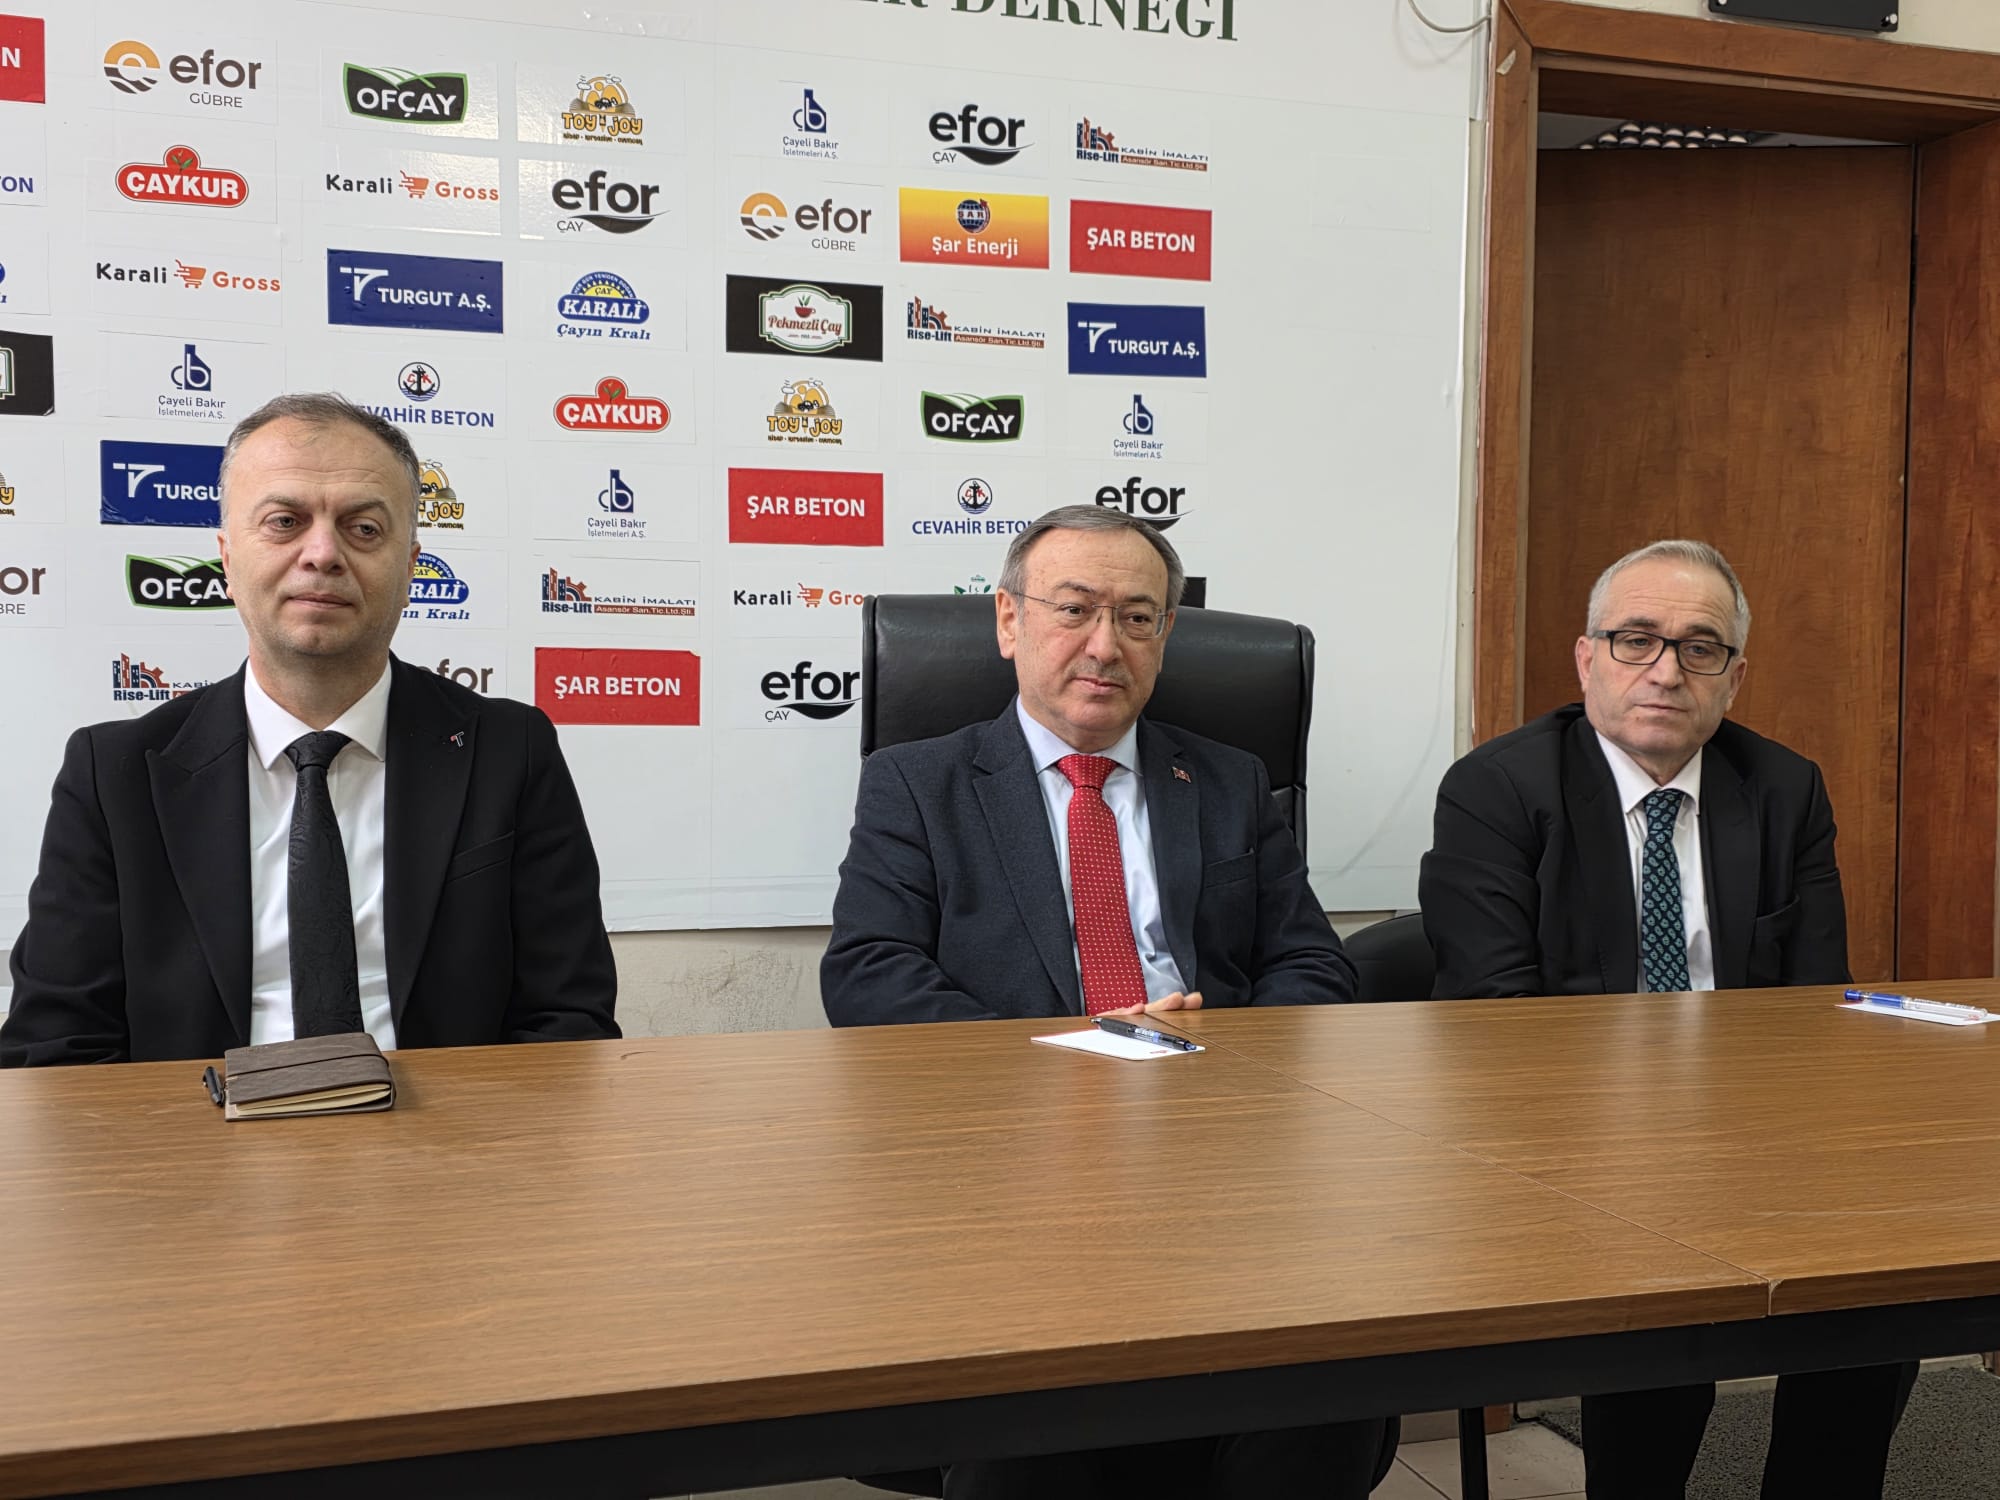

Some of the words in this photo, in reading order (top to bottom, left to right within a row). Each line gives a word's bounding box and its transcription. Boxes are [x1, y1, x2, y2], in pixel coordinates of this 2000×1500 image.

[169, 49, 262, 89] efor
[189, 92, 242, 108] GÜBRE
[356, 87, 456, 117] OFÇAY
[928, 104, 1025, 148] efor
[783, 136, 811, 148] Çayeli
[814, 138, 838, 149] Bakır
[933, 151, 957, 164] ÇAY
[1076, 150, 1119, 163] Rise-Lift
[126, 171, 239, 200] ÇAYKUR
[326, 174, 392, 194] Karali
[434, 181, 499, 201] Gross
[552, 170, 660, 214] efor
[556, 220, 584, 232] ÇAY
[794, 198, 872, 234] efor
[812, 237, 856, 252] GÜBRE
[932, 236, 958, 255] Şar
[968, 237, 1018, 258] Enerji
[1086, 228, 1125, 250] ŞAR
[1130, 231, 1196, 252] BETON
[96, 262, 166, 284] Karali
[212, 271, 280, 292] Gross
[378, 287, 454, 307] TURGUT
[458, 293, 491, 312] A.Ş.
[562, 298, 642, 320] KARALİ
[556, 323, 602, 338] Çayın
[608, 327, 651, 340] Kralı
[768, 315, 819, 331] Pekmezli
[820, 318, 842, 336] Çay
[907, 329, 952, 342] Rise-Lift
[1108, 338, 1168, 355] TURGUT
[1172, 342, 1200, 359] A.Ş.
[158, 394, 192, 408] Çayeli
[196, 398, 226, 408] Bakır
[158, 406, 206, 418] İşletmeleri
[359, 404, 426, 424] VAHİR
[431, 410, 494, 428] BETON
[562, 402, 662, 427] ÇAYKUR
[932, 412, 1014, 438] OFÇAY
[1113, 439, 1138, 450] Çayeli
[1141, 440, 1164, 450] Bakır
[154, 484, 222, 500] TURGU
[1096, 476, 1186, 514] efor
[747, 496, 790, 519] ŞAR
[794, 497, 865, 517] BETON
[588, 517, 618, 529] Çayeli
[620, 518, 646, 528] Bakır
[912, 518, 982, 534] CEVAHİR
[140, 578, 229, 605] OFÇA
[408, 580, 460, 600] RALİ
[734, 590, 792, 605] Karali
[828, 590, 864, 606] Gro
[426, 608, 470, 620] Kralı
[542, 602, 592, 614] Rise-Lift
[594, 595, 636, 604] KABİN
[642, 596, 696, 606] İMALATI
[597, 606, 630, 614] Asansör
[416, 658, 494, 694] for
[761, 661, 860, 700] efor
[114, 690, 170, 701] Rise-Lift
[554, 676, 600, 700] ŞAR
[606, 677, 680, 696] BETON
[765, 710, 790, 722] ÇAY
